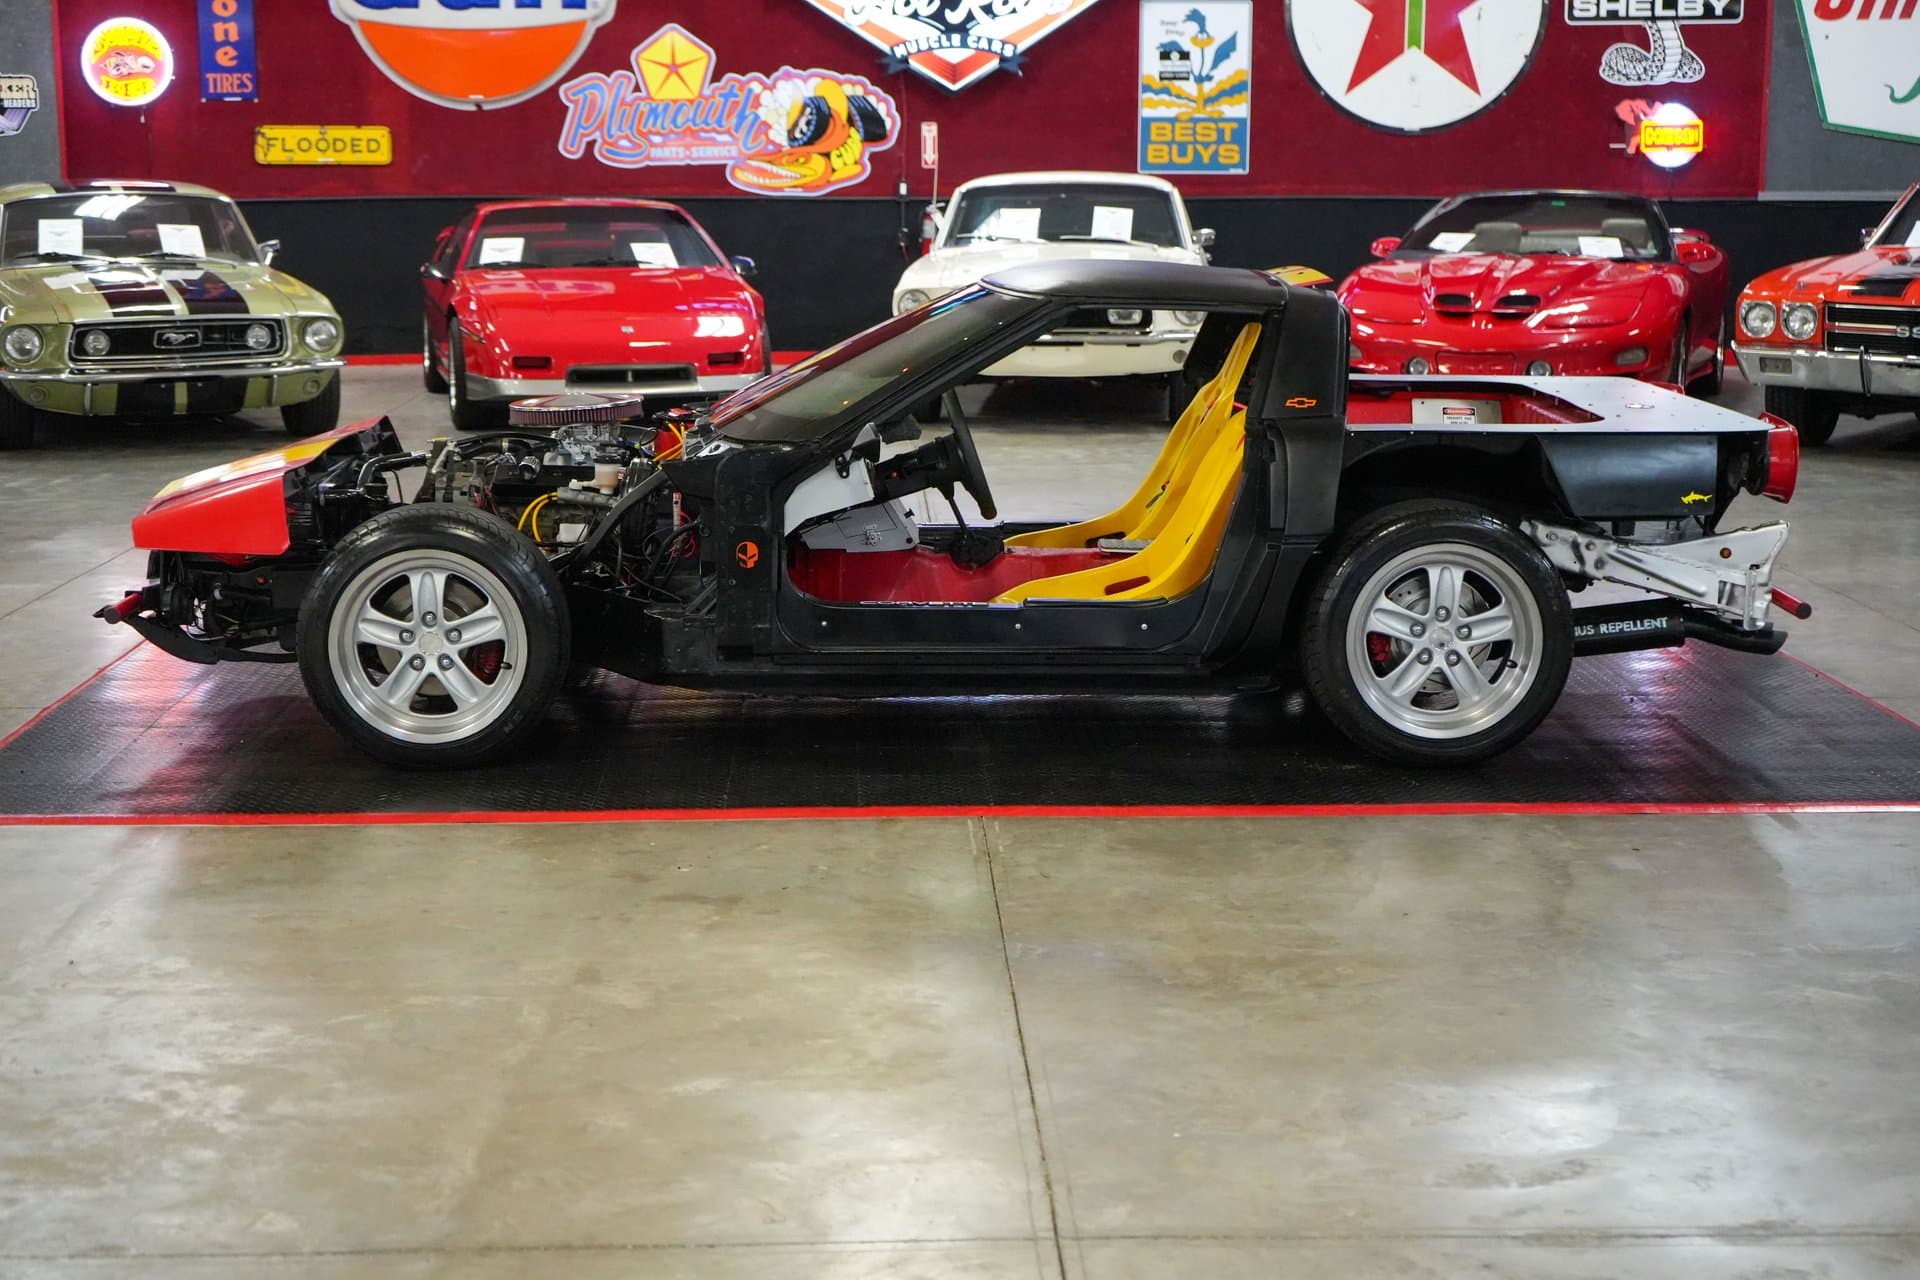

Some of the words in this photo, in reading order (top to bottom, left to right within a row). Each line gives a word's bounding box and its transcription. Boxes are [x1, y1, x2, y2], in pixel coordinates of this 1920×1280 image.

[1572, 0, 1730, 17] SHELBY
[892, 33, 960, 59] MUSCLE
[967, 34, 1015, 57] CARS
[0, 78, 35, 98] KER
[206, 73, 253, 93] TIRES
[567, 78, 766, 159] Plymouth
[1150, 121, 1239, 142] BEST
[266, 137, 381, 153] FLOODED
[1147, 143, 1240, 165] BUYS
[1600, 617, 1668, 634] REPELLENT
